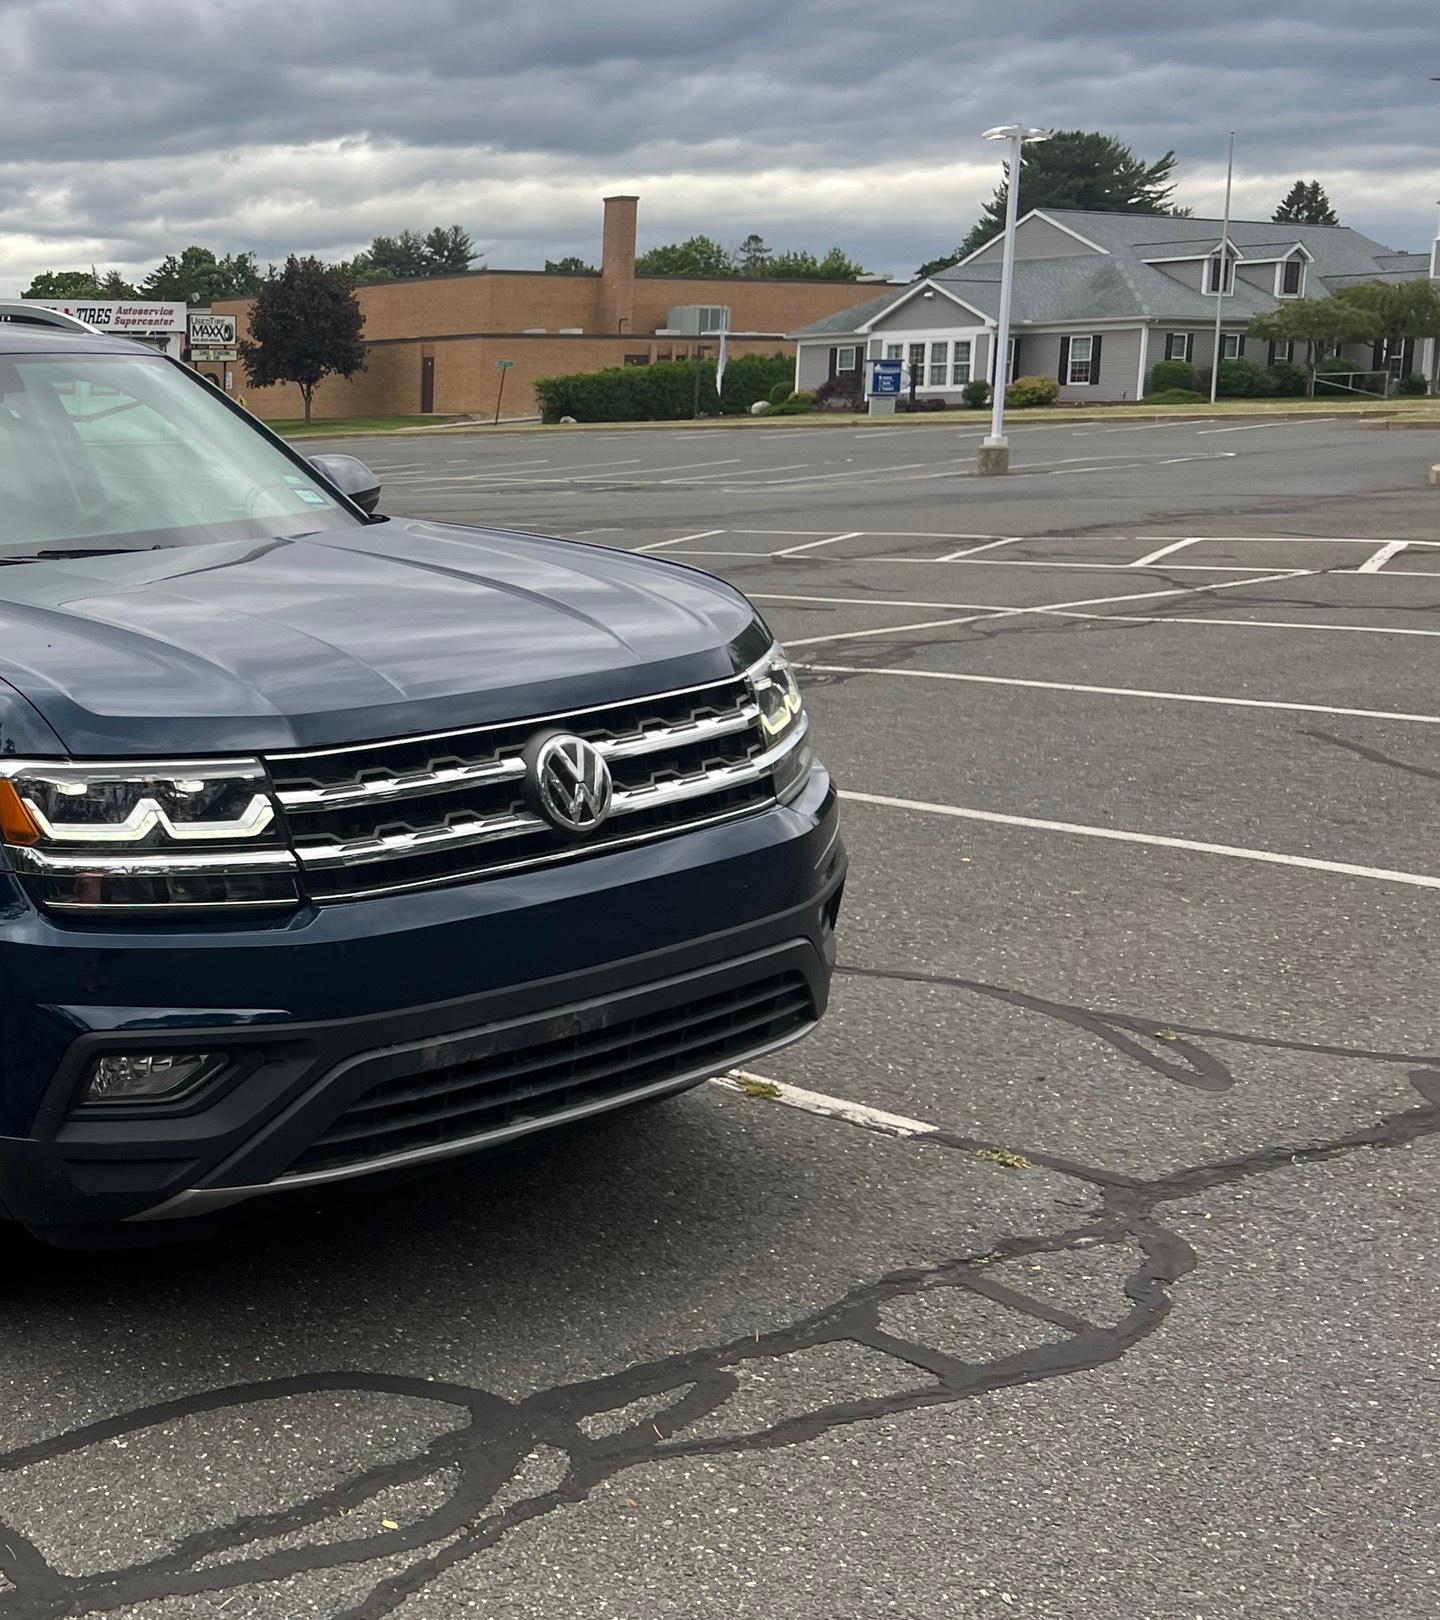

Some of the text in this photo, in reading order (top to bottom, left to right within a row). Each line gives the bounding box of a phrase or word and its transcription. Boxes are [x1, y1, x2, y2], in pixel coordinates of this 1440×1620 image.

[76, 308, 112, 325] TIRES
[115, 306, 174, 316] Autoservice
[114, 316, 175, 327] Supercenter
